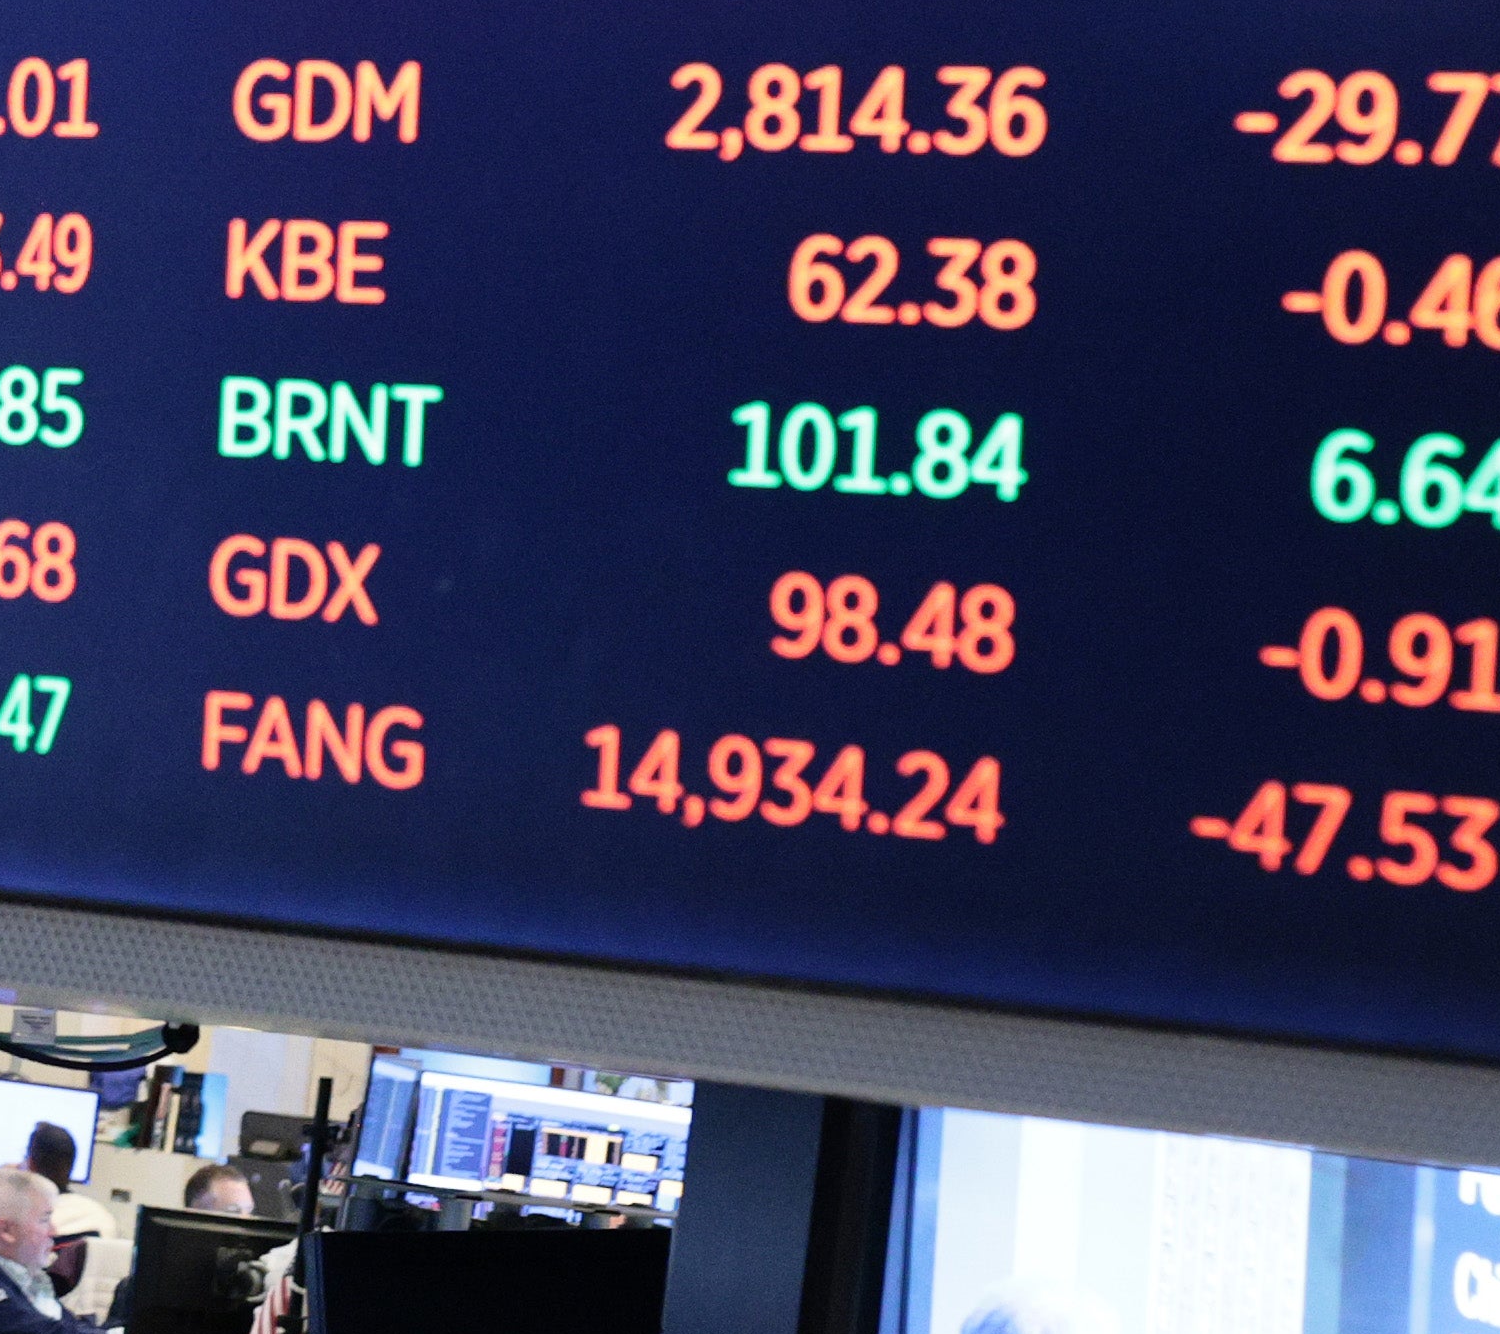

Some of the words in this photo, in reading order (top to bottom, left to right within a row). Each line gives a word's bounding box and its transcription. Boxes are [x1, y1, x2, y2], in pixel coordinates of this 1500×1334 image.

[233, 59, 421, 143] GDM
[666, 63, 1047, 161] 2,814.36
[226, 218, 389, 304] KBE
[789, 234, 1036, 329] 62.38
[219, 376, 443, 467] BRNT
[728, 401, 1028, 501] 101.84
[209, 535, 380, 625] GDX
[771, 572, 1014, 673] 98.48
[202, 691, 424, 789] FANG
[582, 725, 1004, 843] 14,934.24
[1192, 782, 1499, 890] -47.53
